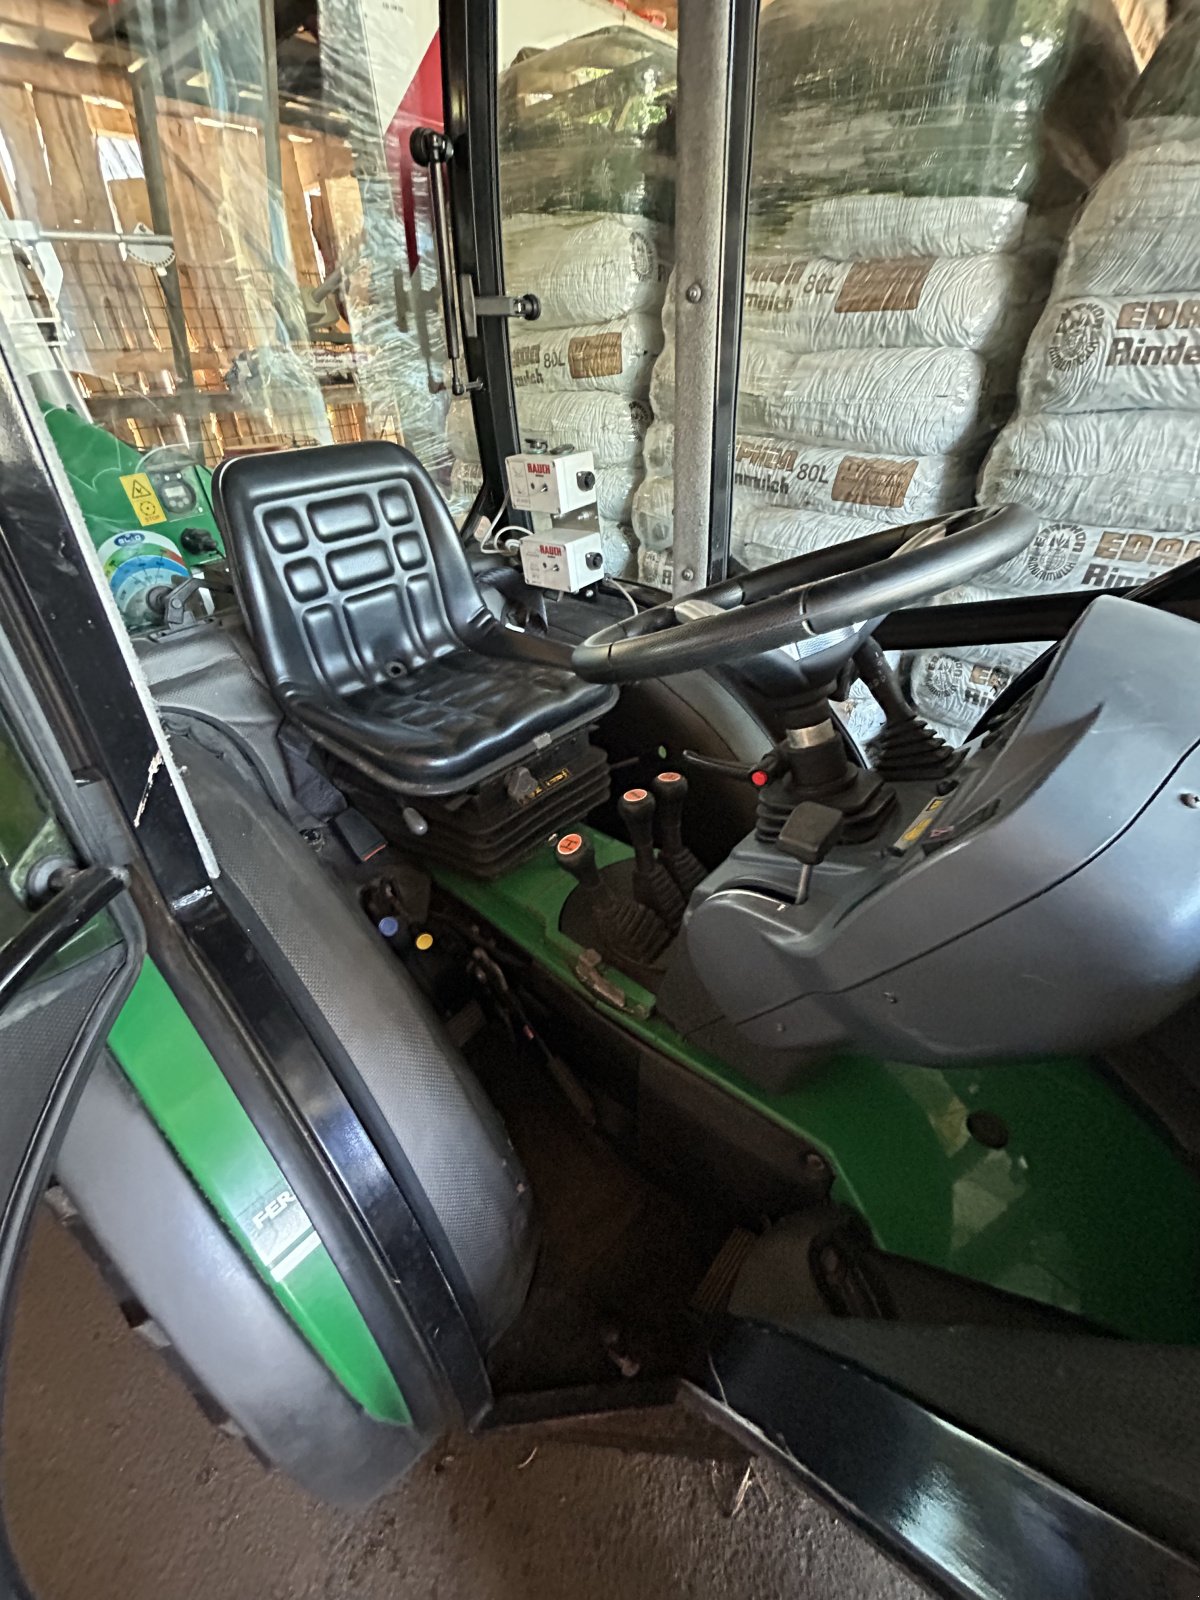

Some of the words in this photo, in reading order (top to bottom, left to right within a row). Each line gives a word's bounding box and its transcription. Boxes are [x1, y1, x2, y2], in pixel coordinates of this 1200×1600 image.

[543, 352, 566, 369] 80L
[527, 463, 551, 475] RAUCH
[796, 462, 829, 484] 80L
[539, 544, 562, 556] RAUCH
